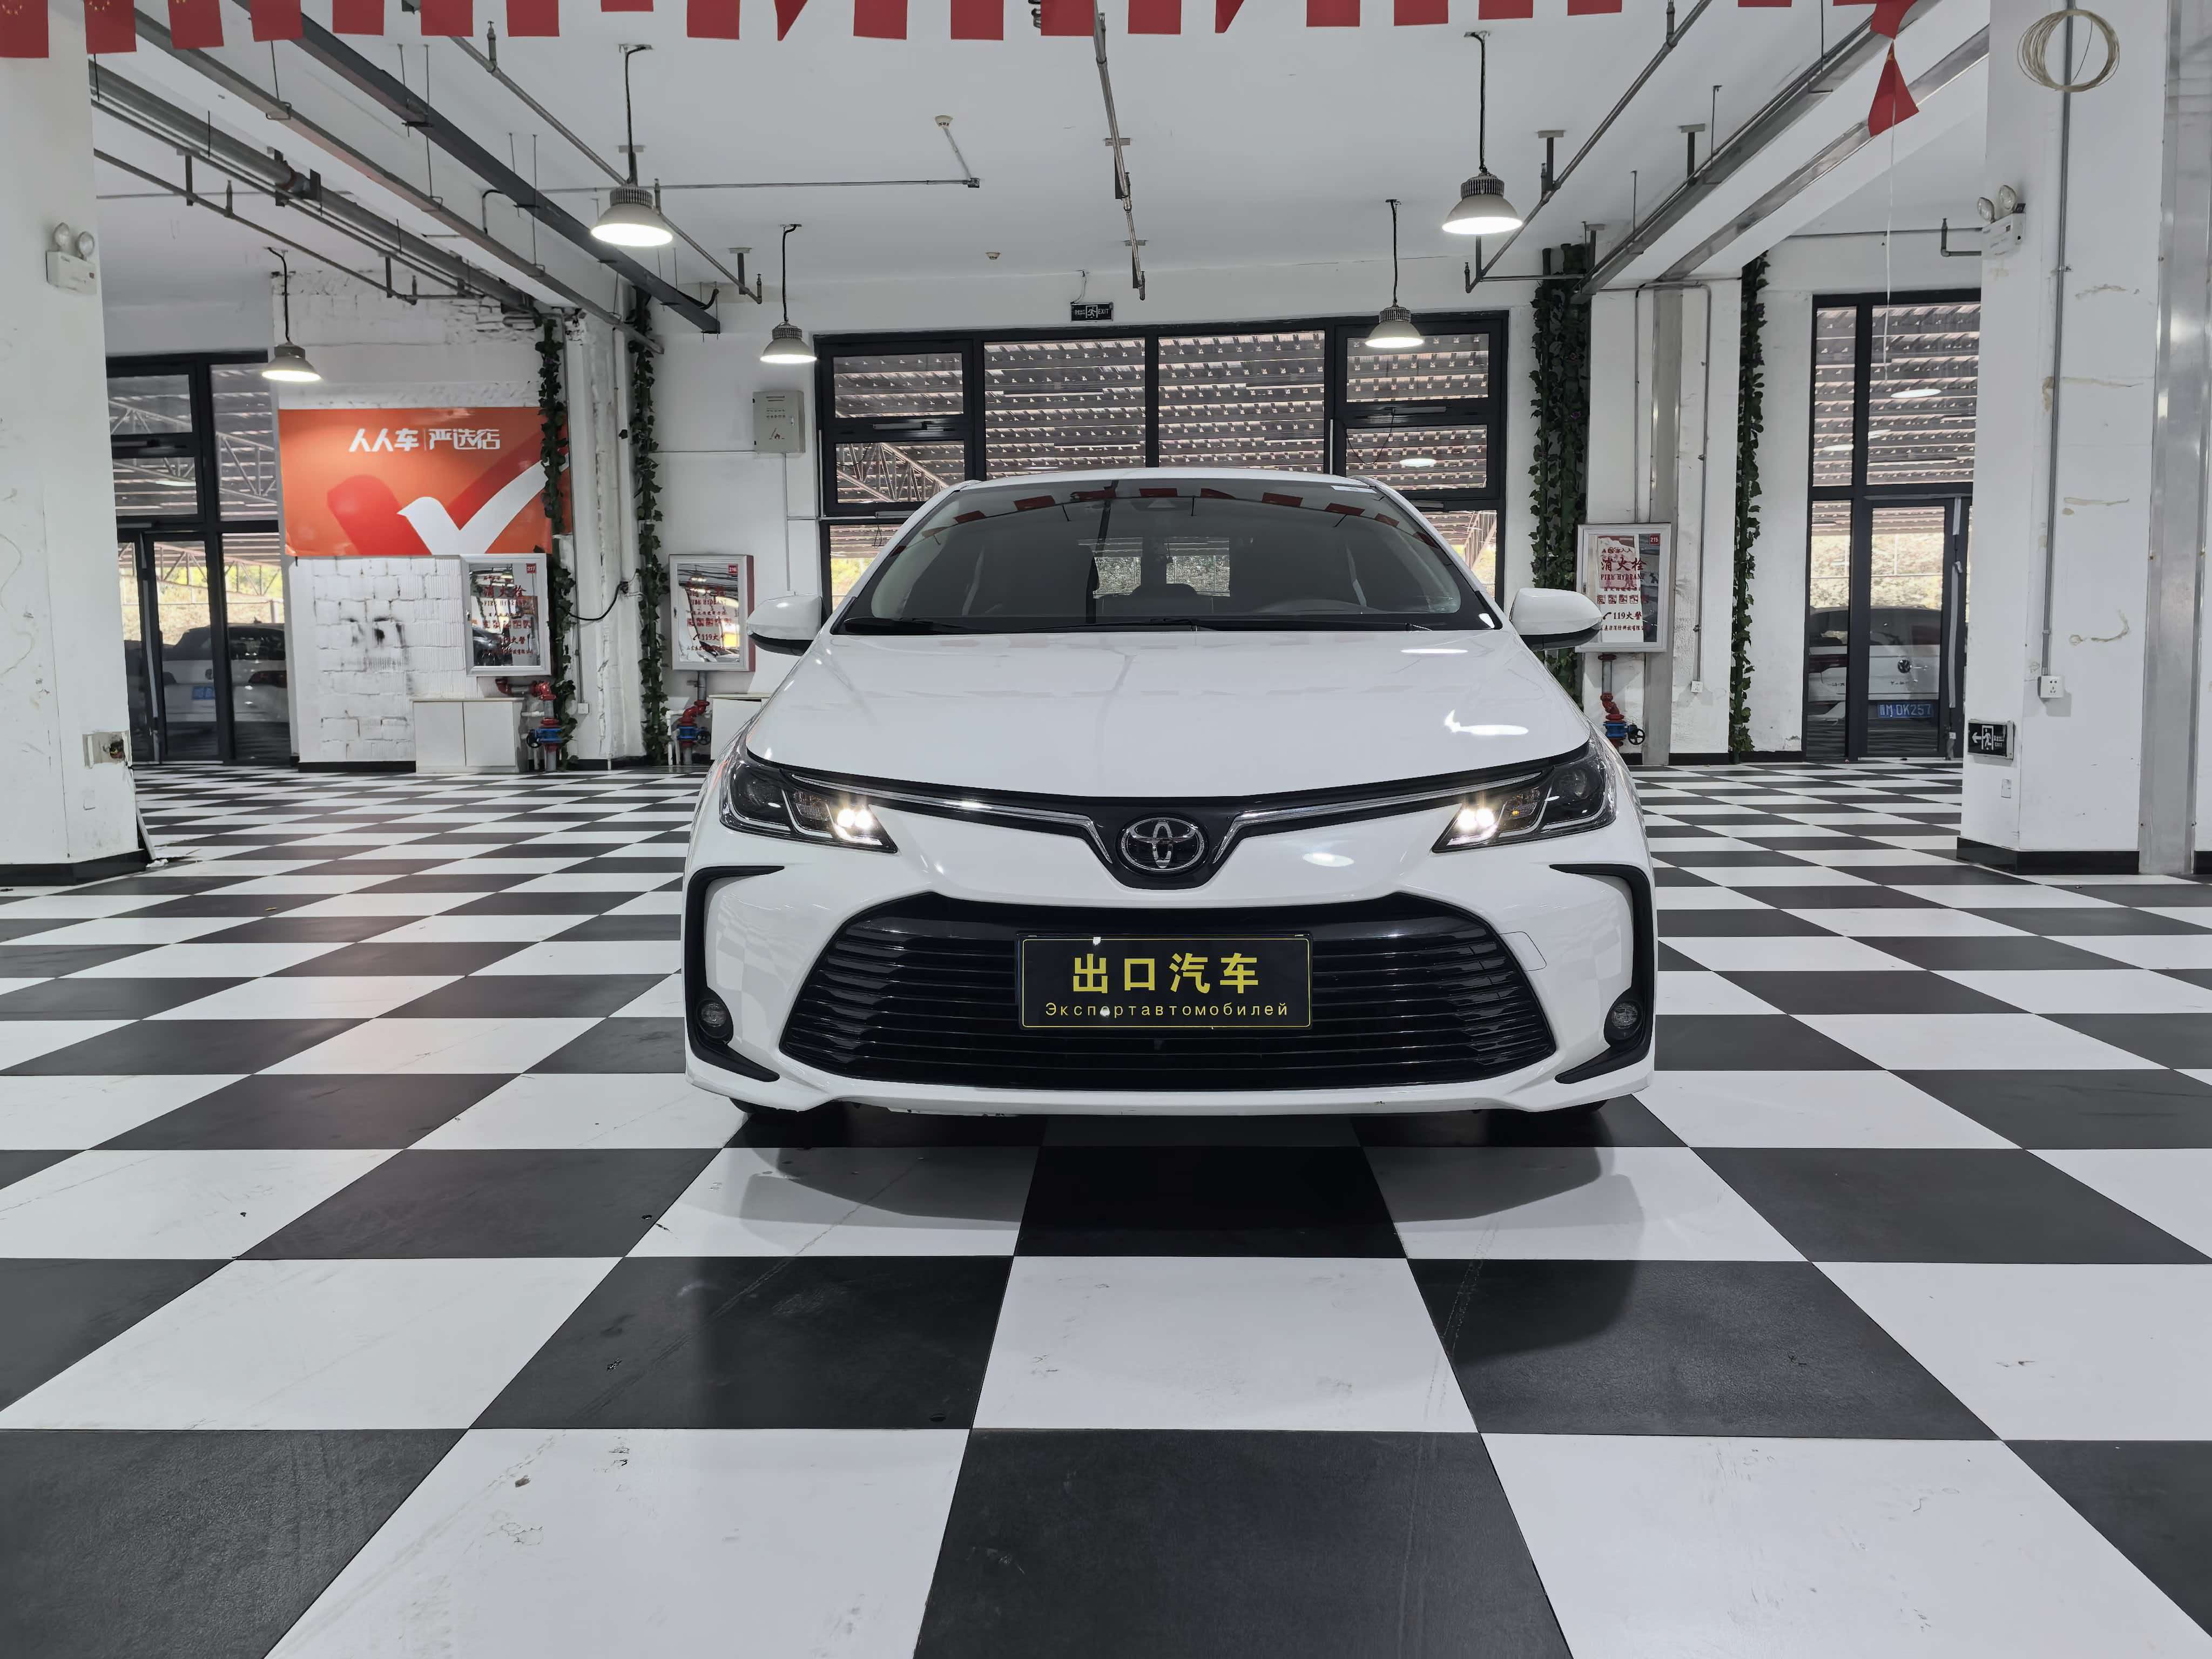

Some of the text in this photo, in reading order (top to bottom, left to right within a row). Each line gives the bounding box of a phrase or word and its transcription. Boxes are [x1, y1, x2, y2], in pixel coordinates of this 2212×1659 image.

[349, 428, 500, 452] 人人车 严选店
[1601, 557, 1647, 571] 消火栓
[1614, 611, 1642, 620] 119火警
[1073, 953, 1259, 994] 出口汽车
